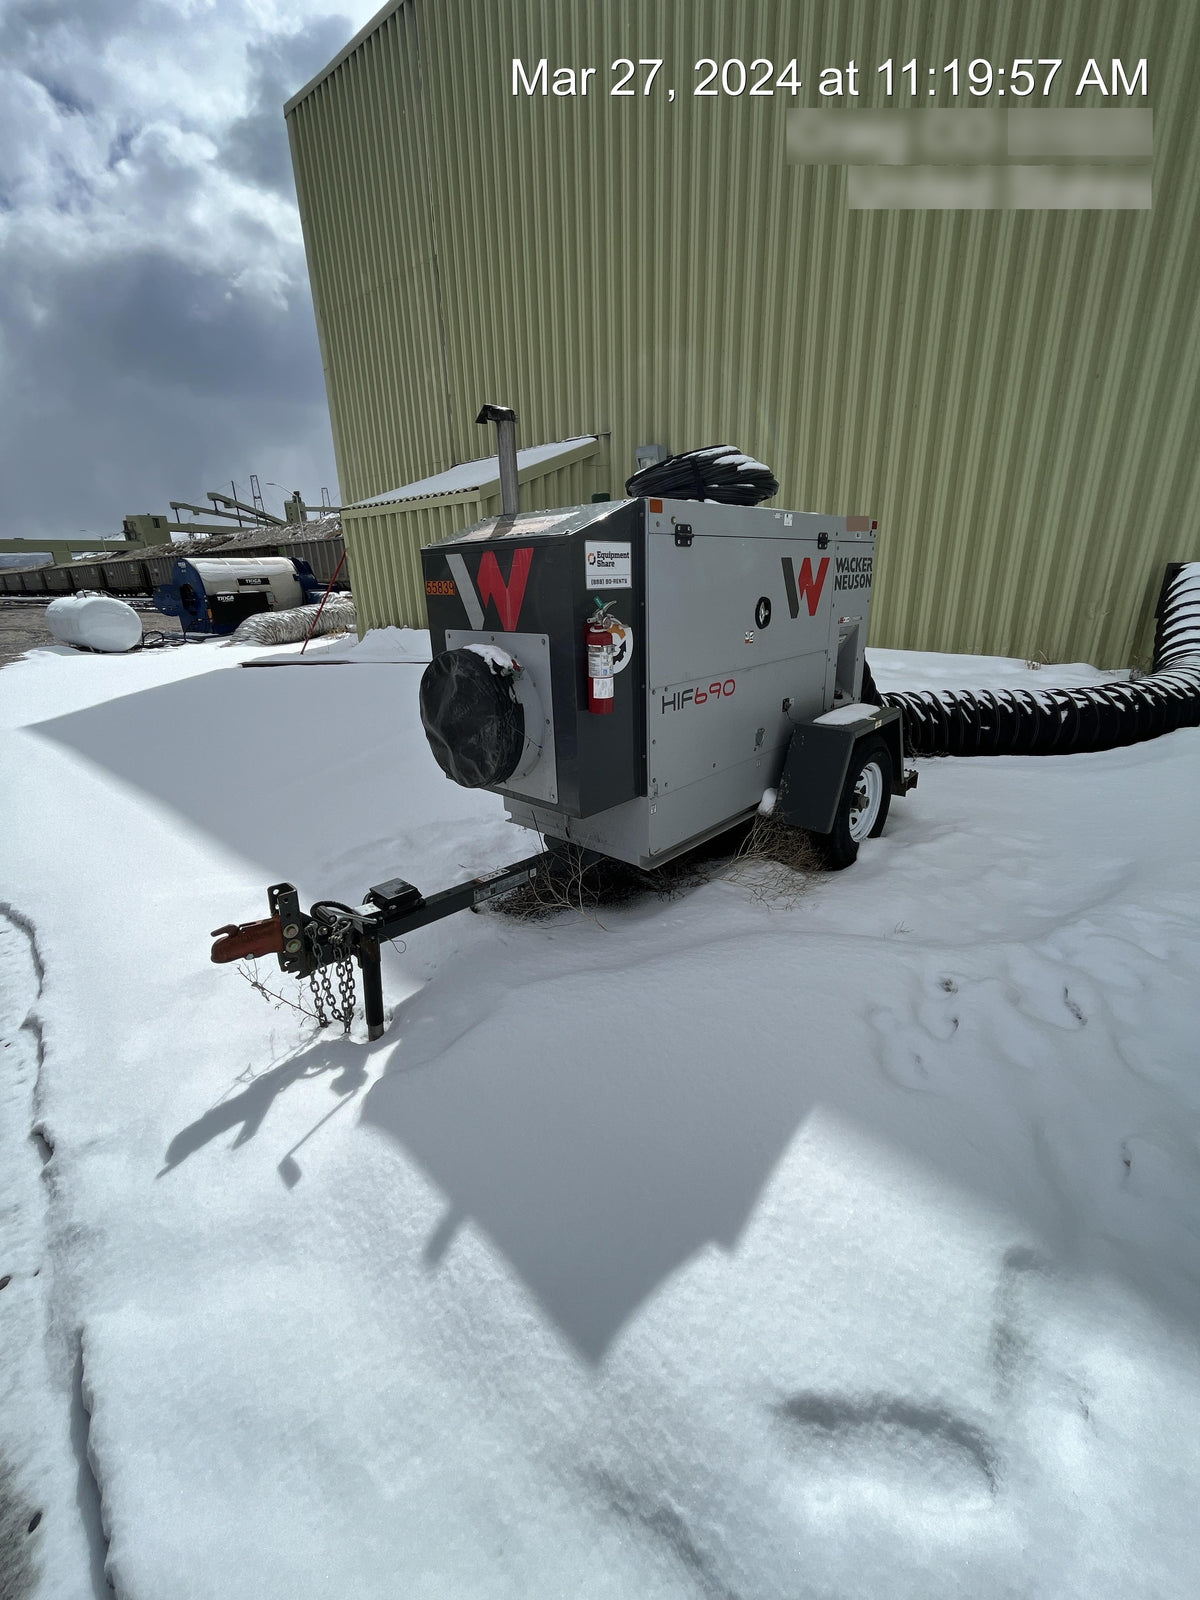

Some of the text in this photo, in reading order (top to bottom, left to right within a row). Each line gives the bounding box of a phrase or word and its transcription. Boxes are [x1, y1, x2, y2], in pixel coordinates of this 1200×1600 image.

[596, 551, 630, 560] Equipment
[596, 560, 616, 568] Share
[835, 557, 873, 573] WACKER
[426, 581, 455, 594] 55839
[834, 573, 873, 591] NEUSON
[661, 678, 736, 715] HIF690
